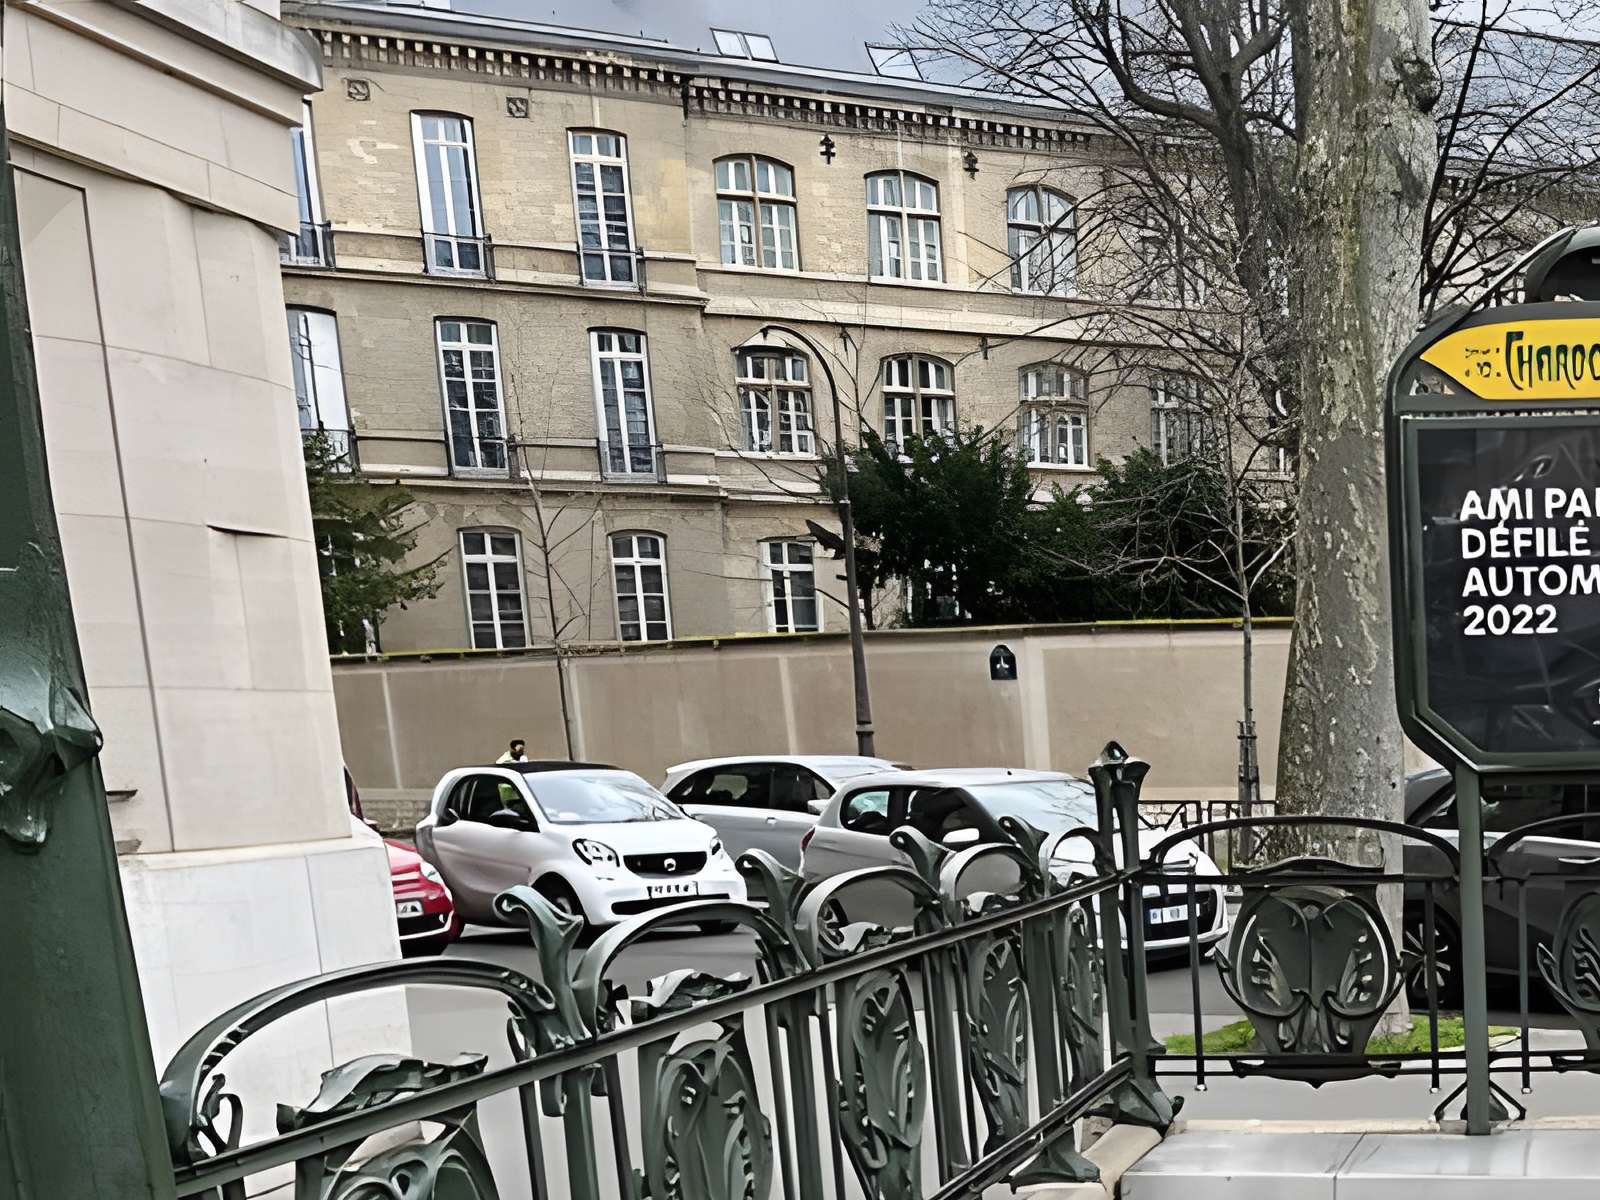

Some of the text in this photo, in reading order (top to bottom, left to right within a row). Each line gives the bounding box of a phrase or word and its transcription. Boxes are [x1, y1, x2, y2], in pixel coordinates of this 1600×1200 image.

[1460, 488, 1533, 521] AMI
[1461, 520, 1591, 559] DÉFILÉ
[1463, 604, 1558, 635] 2022
